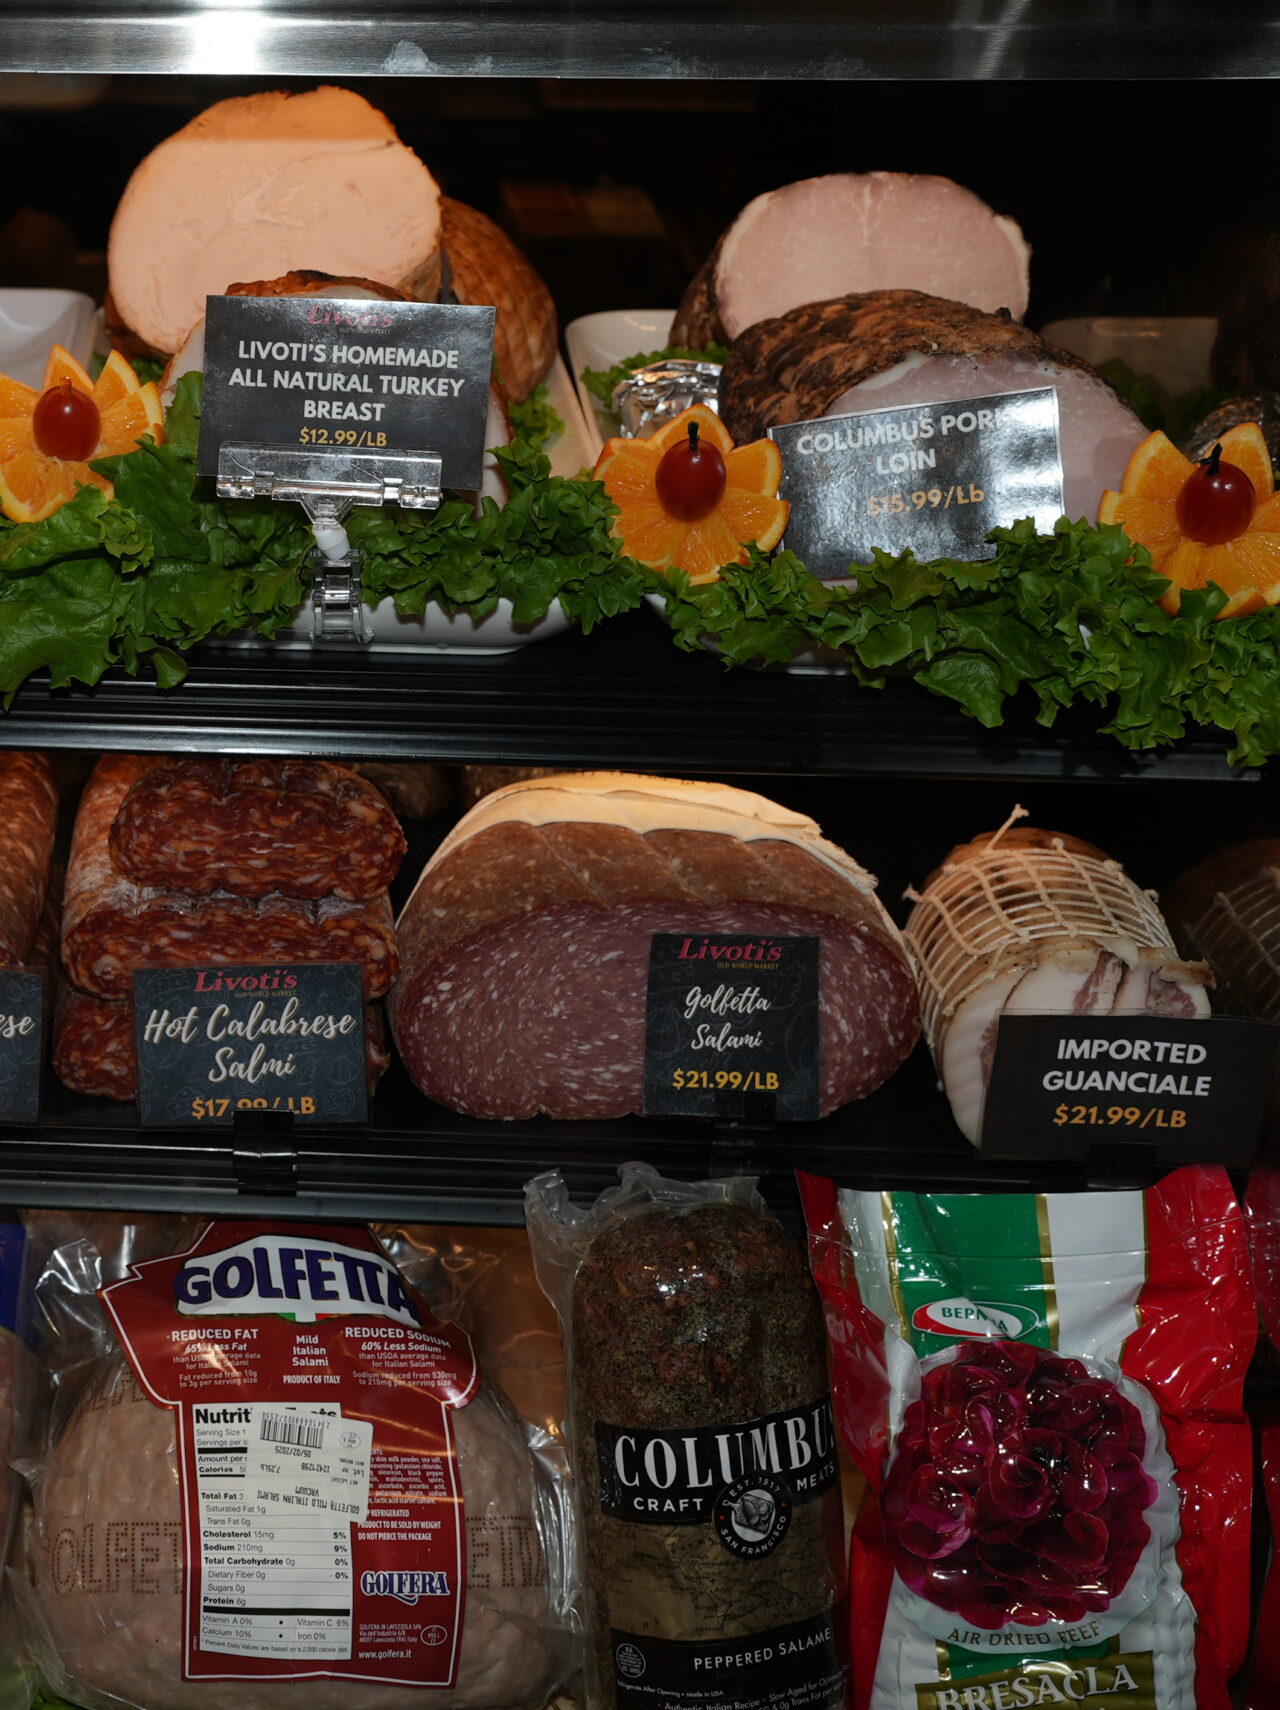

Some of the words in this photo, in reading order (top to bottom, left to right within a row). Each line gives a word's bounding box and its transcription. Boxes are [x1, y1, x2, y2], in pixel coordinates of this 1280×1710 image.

[238, 340, 327, 363] LIVOTI'S
[332, 345, 460, 369] HOMEMADE
[228, 368, 267, 388] ALL
[273, 370, 373, 393] NATURAL
[379, 375, 465, 397] TURKEY
[303, 400, 385, 421] BREAST
[299, 426, 387, 447] $12.99/LB
[796, 417, 935, 455] COLUMBUS
[876, 448, 937, 475] LOIN
[867, 483, 986, 517] $15.99/Lb
[684, 985, 772, 1019] Golfetta
[143, 1006, 200, 1044] Hot
[207, 997, 357, 1041] Calabrese
[691, 1023, 762, 1051] Salami
[1057, 1038, 1207, 1065] IMPORTED
[208, 1043, 297, 1084] Salmi
[672, 1068, 780, 1092] $21.99/LB
[1042, 1070, 1212, 1097] GUANCIALE
[1052, 1103, 1188, 1128] $21.99/LB
[173, 1247, 422, 1328] GOLFETTA
[171, 1329, 231, 1342] REDUCED
[234, 1328, 259, 1340] FAT
[296, 1335, 319, 1344] Mild
[345, 1327, 404, 1338] REDUCED
[407, 1332, 451, 1348] SODIUM
[293, 1347, 326, 1356] Italian
[361, 1342, 382, 1351] 60%
[384, 1342, 405, 1351] Less
[407, 1343, 441, 1353] Sodium
[292, 1357, 328, 1367] Salami
[283, 1375, 312, 1384] PRODUCT
[314, 1375, 322, 1384] OF
[324, 1375, 340, 1384] ITALY
[196, 1429, 223, 1438] Serving
[197, 1439, 228, 1447] Servings
[230, 1440, 242, 1448] per
[198, 1455, 228, 1463] Amount
[230, 1456, 243, 1464] per
[201, 1492, 221, 1500] Total
[223, 1492, 237, 1500] Fat
[633, 1497, 704, 1513] CRAFT
[796, 1461, 835, 1492] MEATS
[729, 1479, 754, 1497] EST.
[758, 1477, 781, 1493] 1917
[206, 1505, 241, 1514] Saturated
[243, 1505, 254, 1513] Fat
[257, 1506, 266, 1515] 1g
[203, 1530, 251, 1539] Cholesterol
[254, 1531, 274, 1540] 15mg
[333, 1531, 347, 1540] 5%
[721, 1528, 739, 1549] SAN
[741, 1515, 787, 1555] FRANCISCO
[203, 1543, 235, 1552] Sodium
[237, 1544, 263, 1553] 210mg
[334, 1545, 348, 1553] 9%
[204, 1557, 225, 1565] Total
[227, 1557, 284, 1566] Carbohydrate
[286, 1558, 295, 1567] 0g
[334, 1558, 348, 1566] 0%
[208, 1570, 234, 1580] Dietary
[235, 1570, 255, 1579] Fiber
[255, 1571, 266, 1580] 0g
[207, 1584, 234, 1593] Sugars
[361, 1571, 450, 1602] GOLFERA
[203, 1596, 235, 1605] Protein
[236, 1597, 246, 1606] 6g
[202, 1627, 233, 1637] Calcium
[235, 1629, 252, 1638] 10%
[297, 1632, 312, 1640] Iron
[313, 1632, 327, 1640] 0%
[948, 1629, 981, 1645] AIR
[989, 1632, 1050, 1646] DRIED
[359, 1650, 412, 1660] www.golfera.it
[694, 1648, 773, 1671] PEPPERED
[779, 1627, 832, 1656] SALAME
